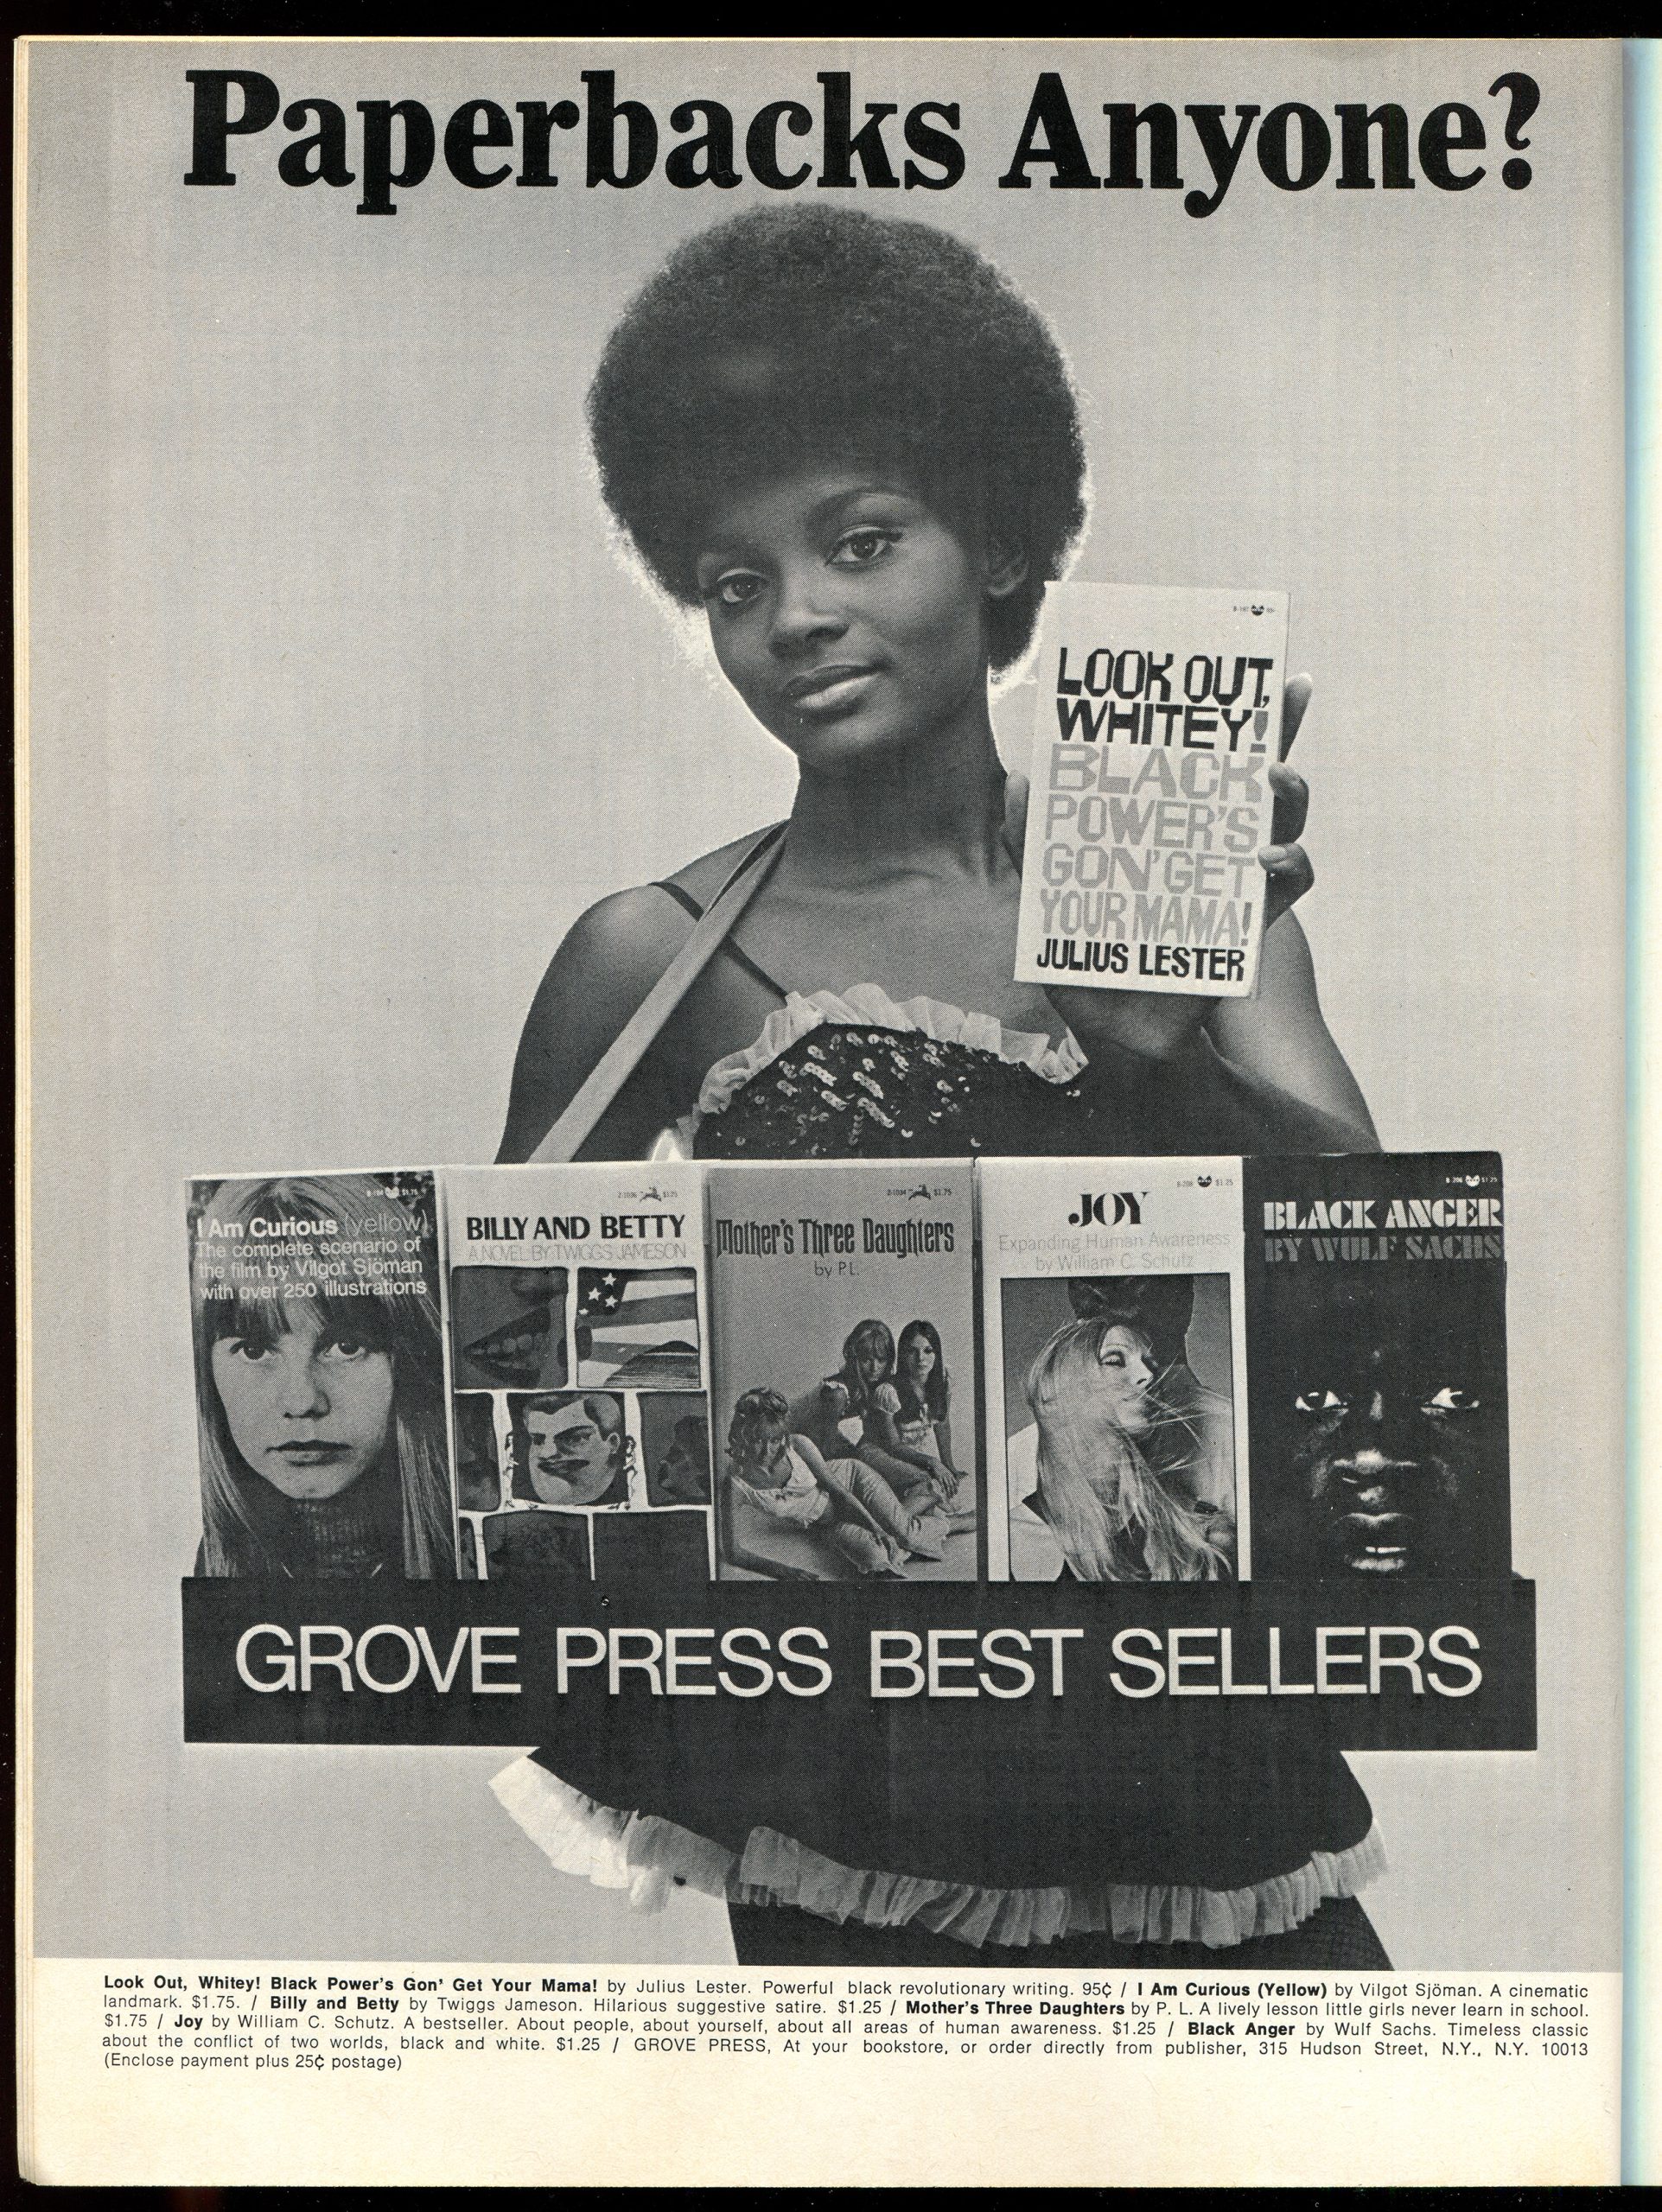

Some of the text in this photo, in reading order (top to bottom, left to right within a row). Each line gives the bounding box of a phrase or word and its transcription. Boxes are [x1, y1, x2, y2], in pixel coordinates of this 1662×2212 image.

[183, 69, 1541, 219] Paperbacks Anyone?
[1057, 647, 1274, 709] LOOK OUT,
[1056, 697, 1269, 753] WHITEY!
[1049, 742, 1264, 802] BLACK
[1045, 793, 1258, 854] POWER'S
[1040, 887, 1252, 947] YOUR MAMA!
[1037, 938, 1245, 982] JULIUS LESTER
[1068, 1191, 1149, 1228] JOY
[1264, 1198, 1503, 1230] BLACK ANGER
[197, 1217, 202, 1237] I
[208, 1218, 245, 1238] Am
[249, 1216, 339, 1237] Curious
[466, 1214, 685, 1241] BILLY AND BETTY
[716, 1218, 954, 1259] Mother's Three Daughters
[195, 1236, 421, 1259] The complete scenario of
[468, 1243, 687, 1262] A NOVEL BY TWIGGS JAMESON
[999, 1231, 1231, 1254] Expanding Human Awareness
[1264, 1236, 1502, 1262] BY WULF SACHS
[199, 1258, 423, 1281] the film by Vilgot Sjöman
[814, 1261, 832, 1278] by
[1036, 1255, 1053, 1274] by
[1057, 1255, 1114, 1272] William
[1141, 1252, 1194, 1268] Schutz
[200, 1278, 427, 1300] with over 250 illustrations
[235, 1624, 1482, 1698] GROVE PRESS BEST SELLERS
[104, 1974, 144, 1989] Look
[153, 1974, 188, 1992] Out,
[198, 1975, 260, 1993] Whitey!
[271, 1976, 318, 1991] Black
[328, 1976, 394, 1991] Power's
[403, 1977, 444, 1992] Gon'
[452, 1977, 483, 1992] Get
[491, 1978, 532, 1993] Your
[541, 1978, 597, 1993] Mama!
[608, 1979, 627, 1996] by
[636, 1979, 685, 1993] Julius
[697, 1980, 751, 1994] Lester.
[763, 1980, 833, 1995] Powerful
[848, 1980, 892, 1995] black
[900, 1980, 1006, 1999] revolutionary
[1012, 1981, 1074, 1999] writing.
[1137, 1981, 1143, 1996] I
[1149, 1982, 1178, 1997] Am
[1185, 1981, 1251, 1997] Curious
[1258, 1982, 1328, 1999] (Yellow)
[1334, 1982, 1353, 1999] by
[1360, 1982, 1408, 1999] Vilgot
[1415, 1982, 1482, 1999] Sjöman.
[1489, 1983, 1502, 1998] A
[1509, 1983, 1589, 1999] cinematic
[104, 1994, 182, 2009] landmark.
[192, 1994, 239, 2009] $1.75.
[271, 1995, 308, 2012] Billy
[316, 1995, 347, 2010] and
[357, 1996, 399, 2013] Betty
[409, 1996, 428, 2013] by
[436, 1997, 495, 2014] Twiggs
[505, 1997, 583, 2012] Jameson.
[594, 1998, 667, 2012] Hilarious
[677, 1999, 766, 2016] suggestive
[775, 1999, 826, 2014] satire.
[837, 1999, 882, 2015] $1.25
[906, 2000, 979, 2015] Mother's
[984, 2000, 1033, 2015] Three
[1039, 2000, 1125, 2018] Daughters
[1131, 2001, 1149, 2018] by
[1199, 2001, 1211, 2016] A
[1218, 2001, 1260, 2018] lively
[1267, 2002, 1318, 2016] lesson
[1326, 2002, 1362, 2016] little
[1368, 2002, 1404, 2018] girls
[1411, 2005, 1456, 2017] never
[1462, 2002, 1503, 2017] learn
[1511, 2003, 1525, 2017] in
[1531, 2003, 1589, 2018] school.
[102, 2033, 1589, 2057] about the conflict of two worlds, black and white. $1.25 GROVE PRESS, At your bookstore, or order directly from publisher, 315 Hudson Street, N.Y., N.Y. 10013
[105, 2052, 174, 2069] (Enclose
[181, 2054, 249, 2070] payment
[256, 2054, 290, 2070] plus
[332, 2055, 402, 2072] postage)
